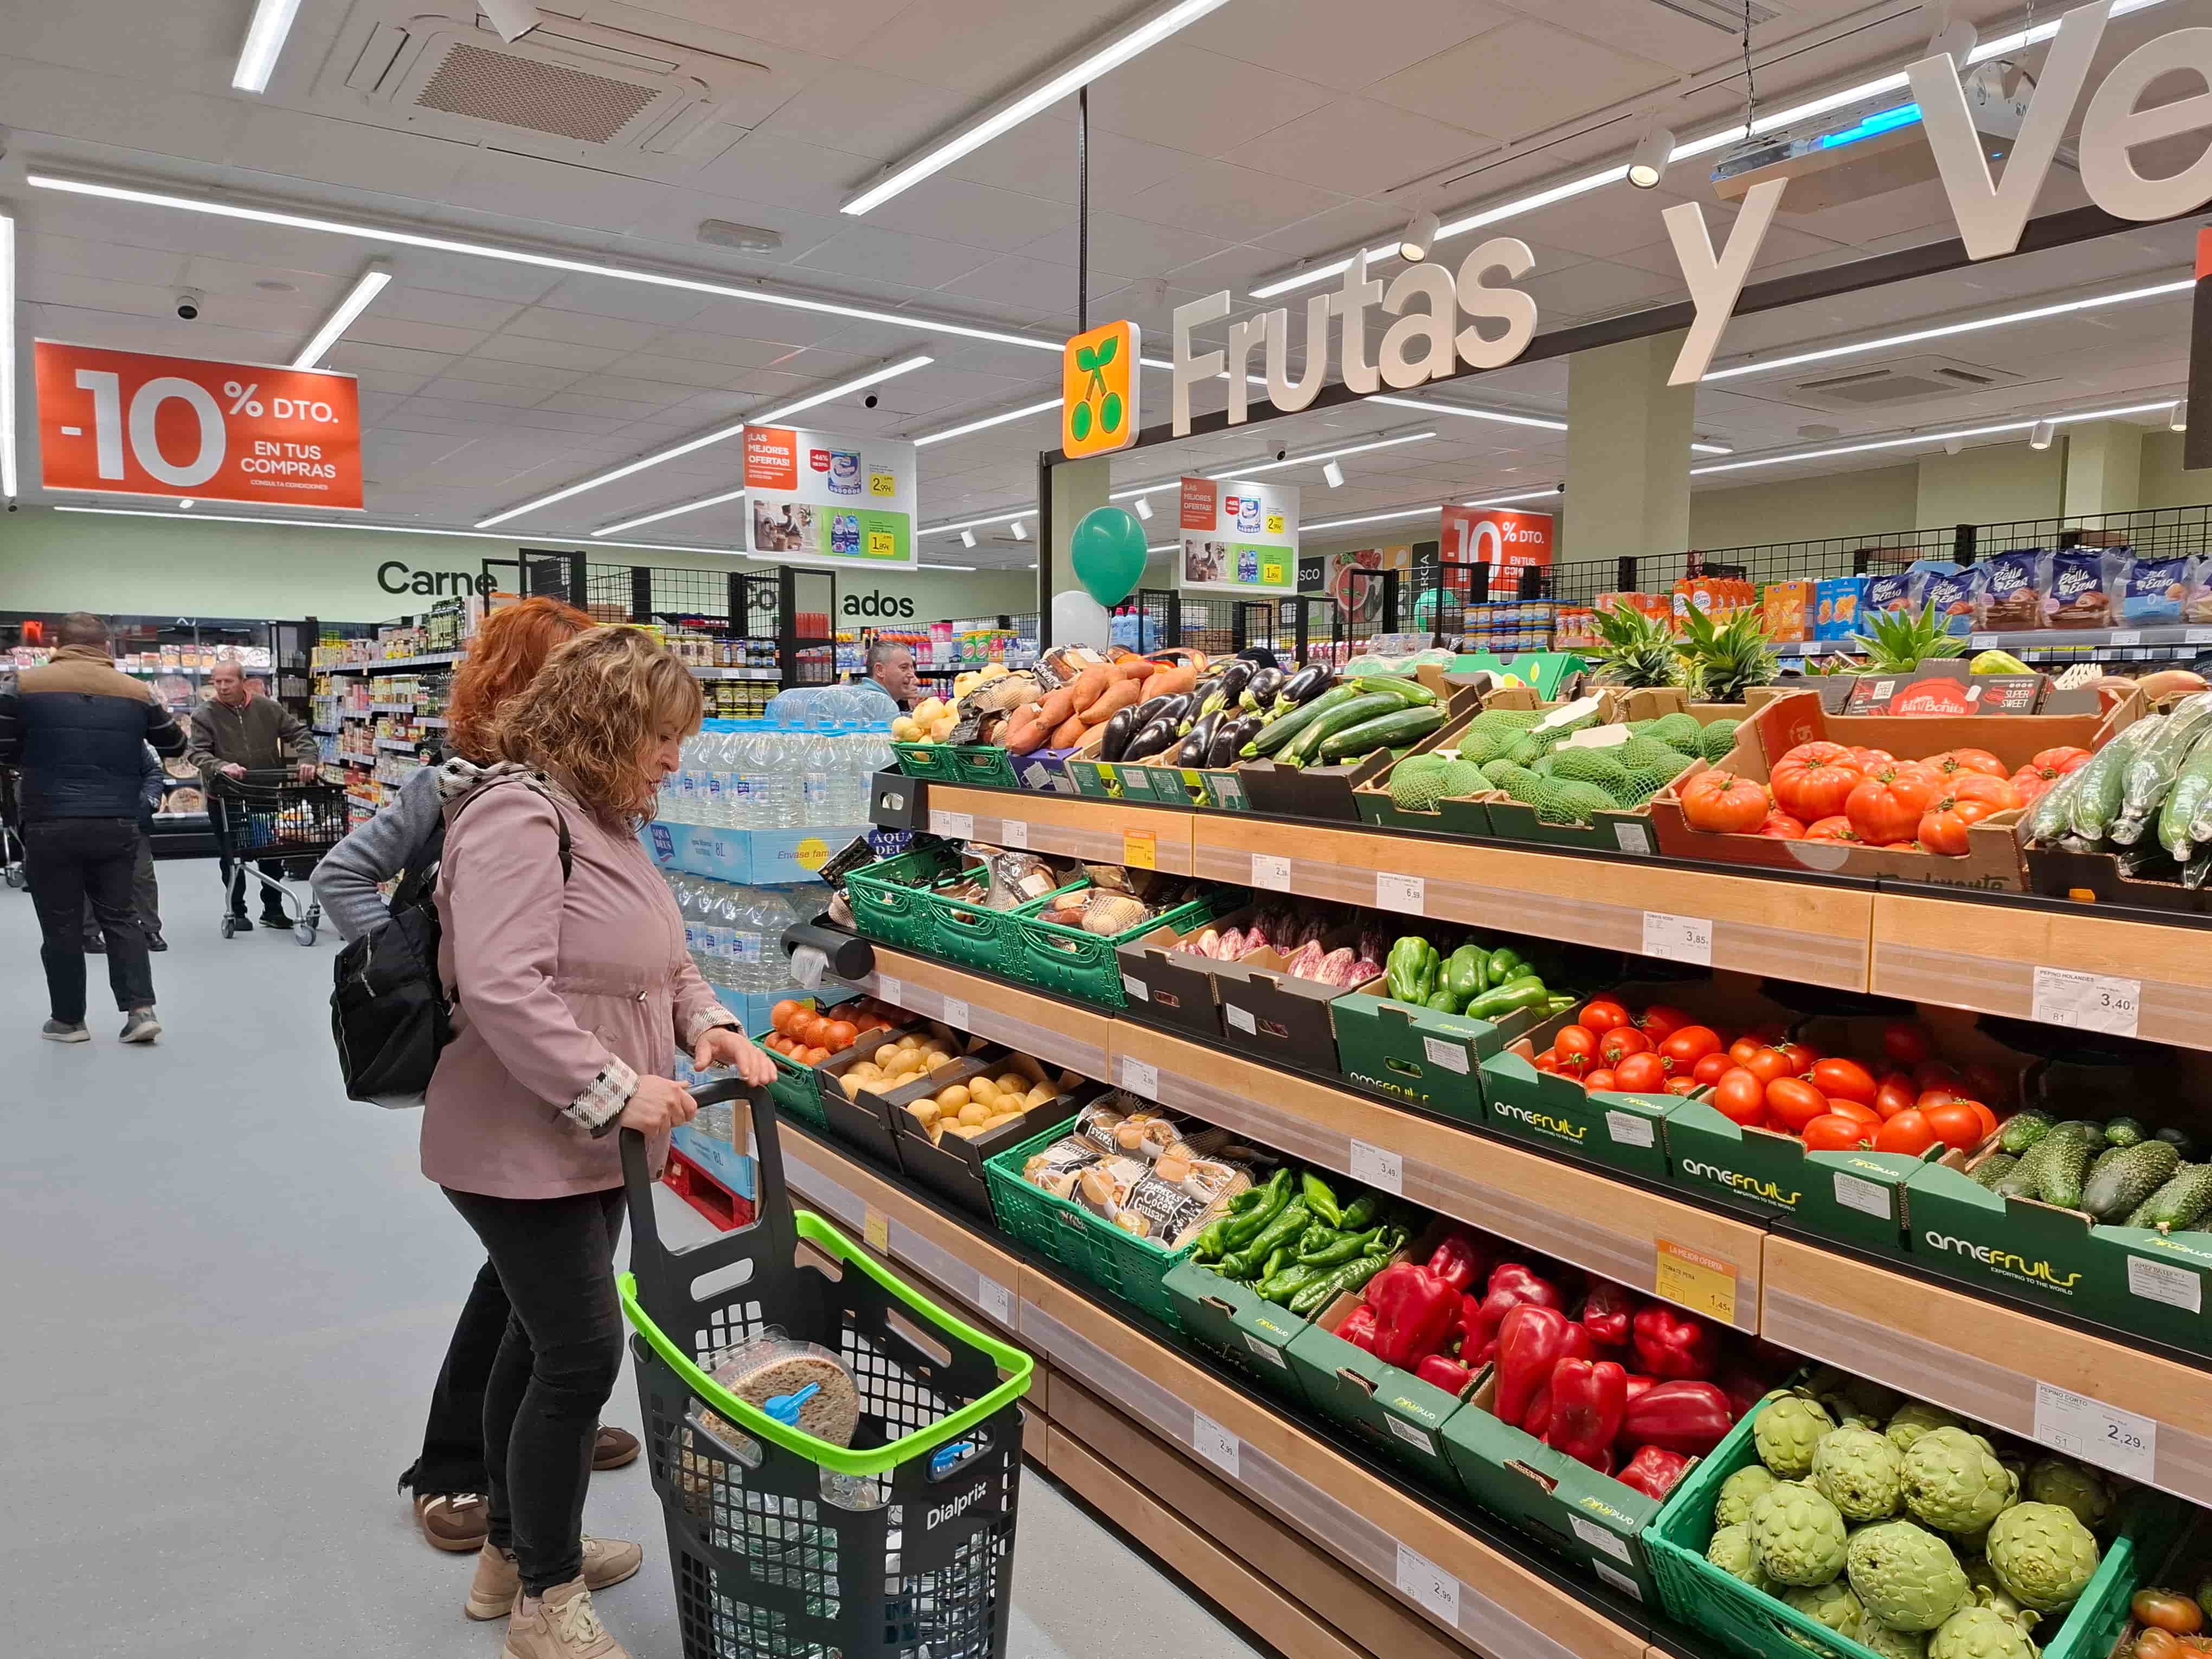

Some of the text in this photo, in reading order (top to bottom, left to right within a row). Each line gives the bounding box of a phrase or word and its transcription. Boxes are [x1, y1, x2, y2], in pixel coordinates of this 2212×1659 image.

[1173, 237, 1538, 438] Frutas
[1661, 177, 1788, 386] y
[273, 397, 339, 423] DTO.
[254, 440, 321, 460] EN TUS
[748, 444, 789, 455] MEJORES
[241, 458, 336, 478] COMPRAS
[1519, 530, 1545, 544] DTO.
[1522, 557, 1536, 565] TUS
[377, 560, 498, 596] Carne
[1297, 568, 1320, 581] SCO
[2000, 699, 2028, 708] SWEET
[2004, 690, 2030, 698] SUPER
[777, 850, 810, 860] Envase
[2040, 970, 2095, 982] PEPINO HOLANDES
[1134, 1196, 1165, 1223] Guisar
[1143, 1190, 1172, 1214] Cocer
[1990, 1266, 2073, 1296] EXPORTING TO THE WORLD
[2040, 1385, 2088, 1407] PEPINO CORTO
[2054, 1435, 2067, 1448] 51
[926, 1481, 987, 1531] Dialprix
